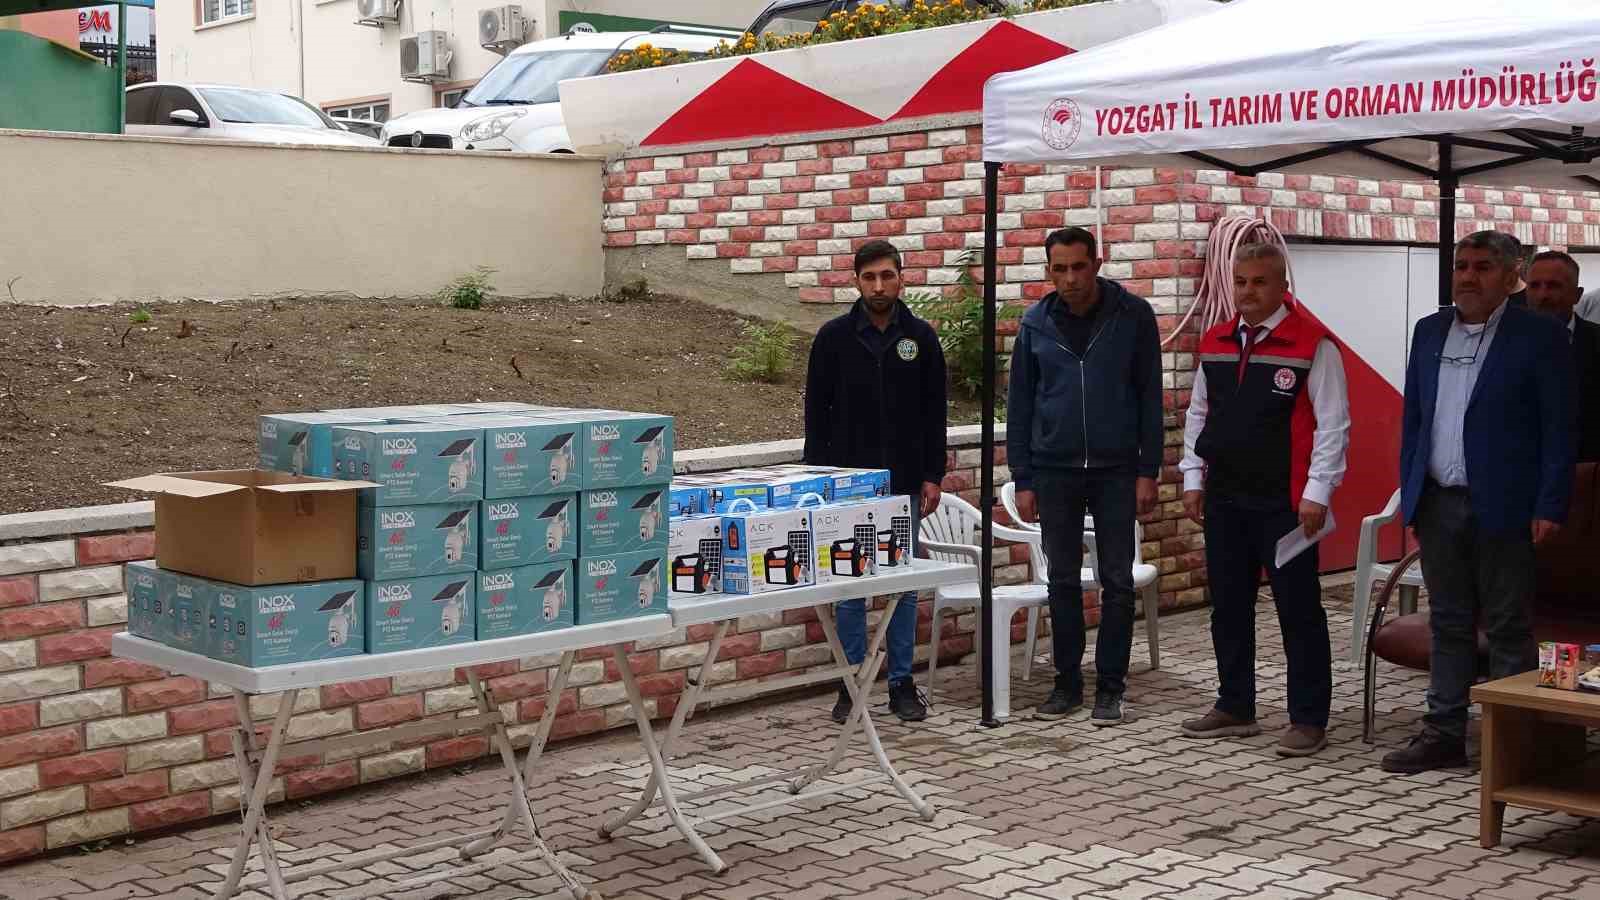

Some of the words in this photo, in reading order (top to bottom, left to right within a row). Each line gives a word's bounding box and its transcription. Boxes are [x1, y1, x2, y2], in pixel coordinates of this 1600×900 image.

[1095, 102, 1178, 136] YOZGAT
[1184, 93, 1203, 129] İL
[1209, 93, 1282, 128] TARIM
[1290, 90, 1318, 121] VE
[1325, 81, 1424, 119] ORMAN
[1431, 58, 1597, 112] MÜDÜRLÜĞ
[590, 424, 620, 436] INOX
[382, 438, 417, 449] INOX
[495, 432, 526, 443] INOX
[589, 490, 617, 503] INOX
[488, 503, 519, 515] INOX
[381, 511, 415, 524] INOX
[816, 515, 840, 526] ACK
[669, 530, 684, 538] CK
[587, 559, 616, 572] INOX
[482, 573, 513, 586] INOX
[378, 583, 411, 596] INOX
[258, 593, 295, 608] INOX
